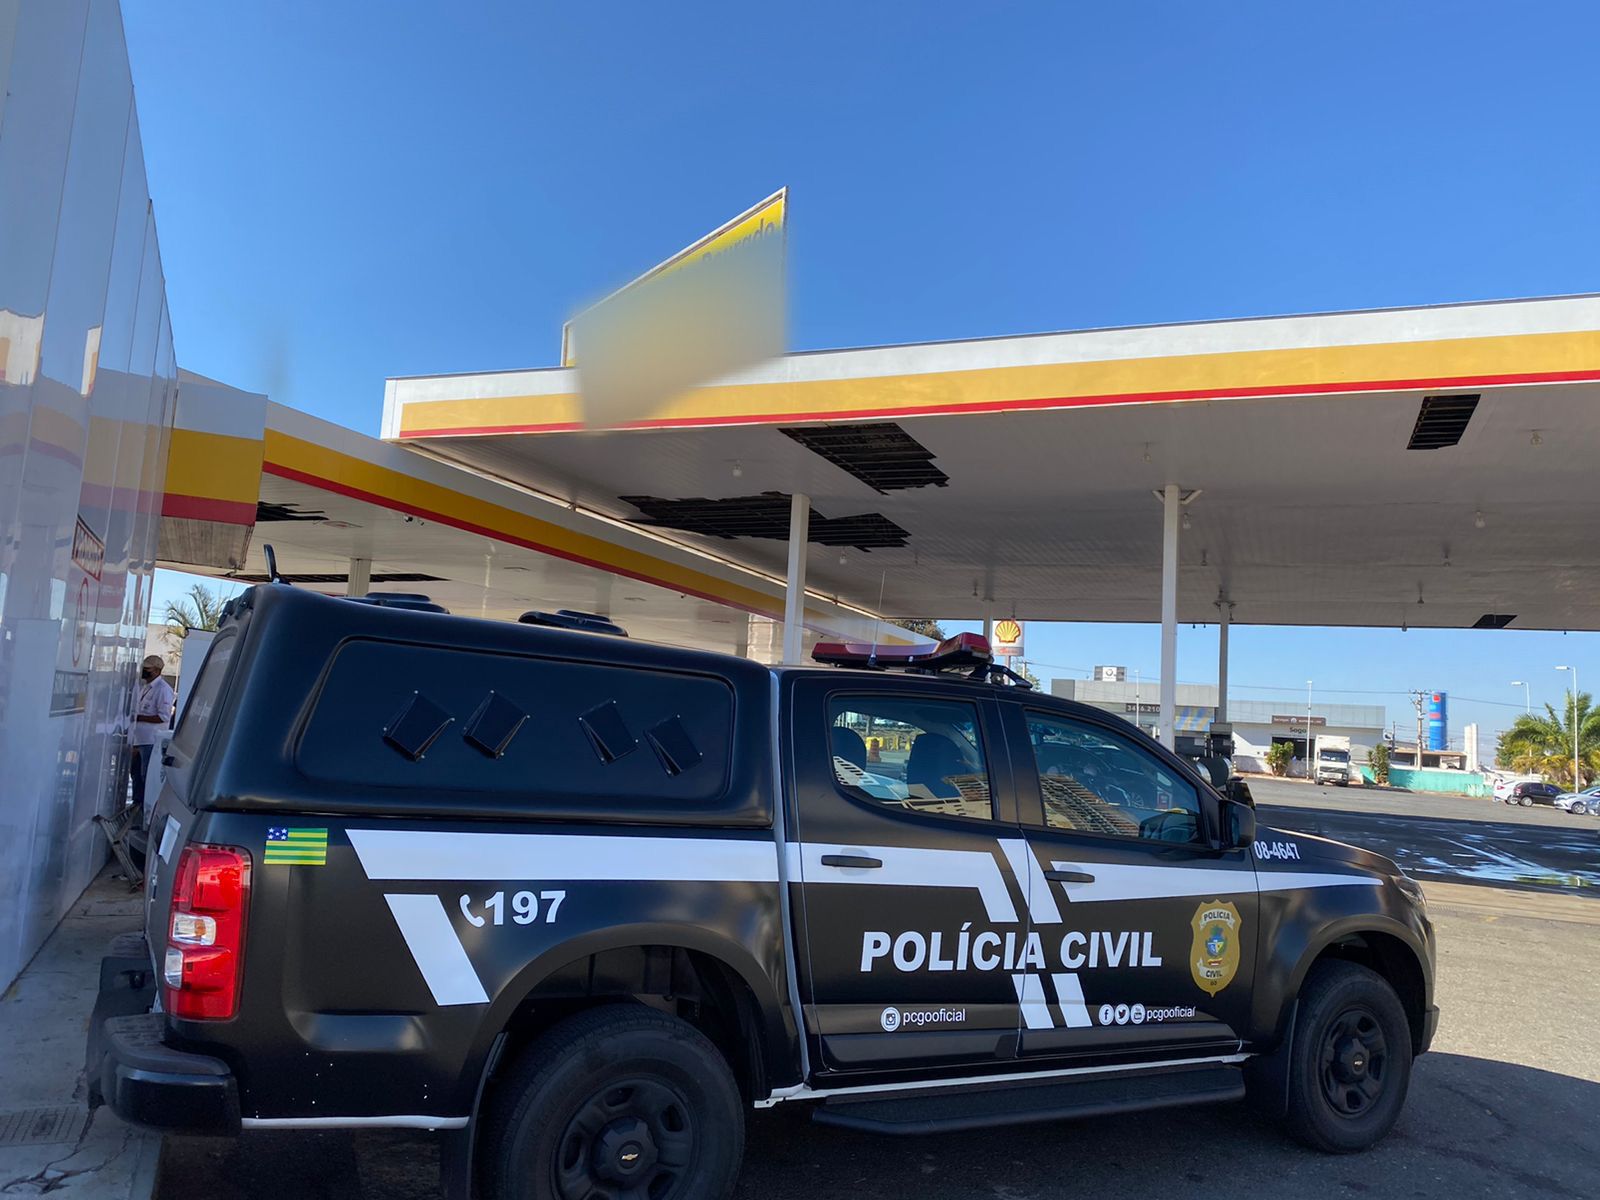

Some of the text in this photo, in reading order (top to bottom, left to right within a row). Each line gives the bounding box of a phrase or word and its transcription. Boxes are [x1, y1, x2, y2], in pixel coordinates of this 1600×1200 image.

[1253, 840, 1301, 860] 08-4647
[484, 890, 566, 925] 197
[860, 922, 1163, 972] POLÍCIA CIVIL
[1205, 970, 1223, 978] CIVIL
[902, 1008, 967, 1026] pcgooficial
[1146, 1006, 1197, 1021] pcgooficial
